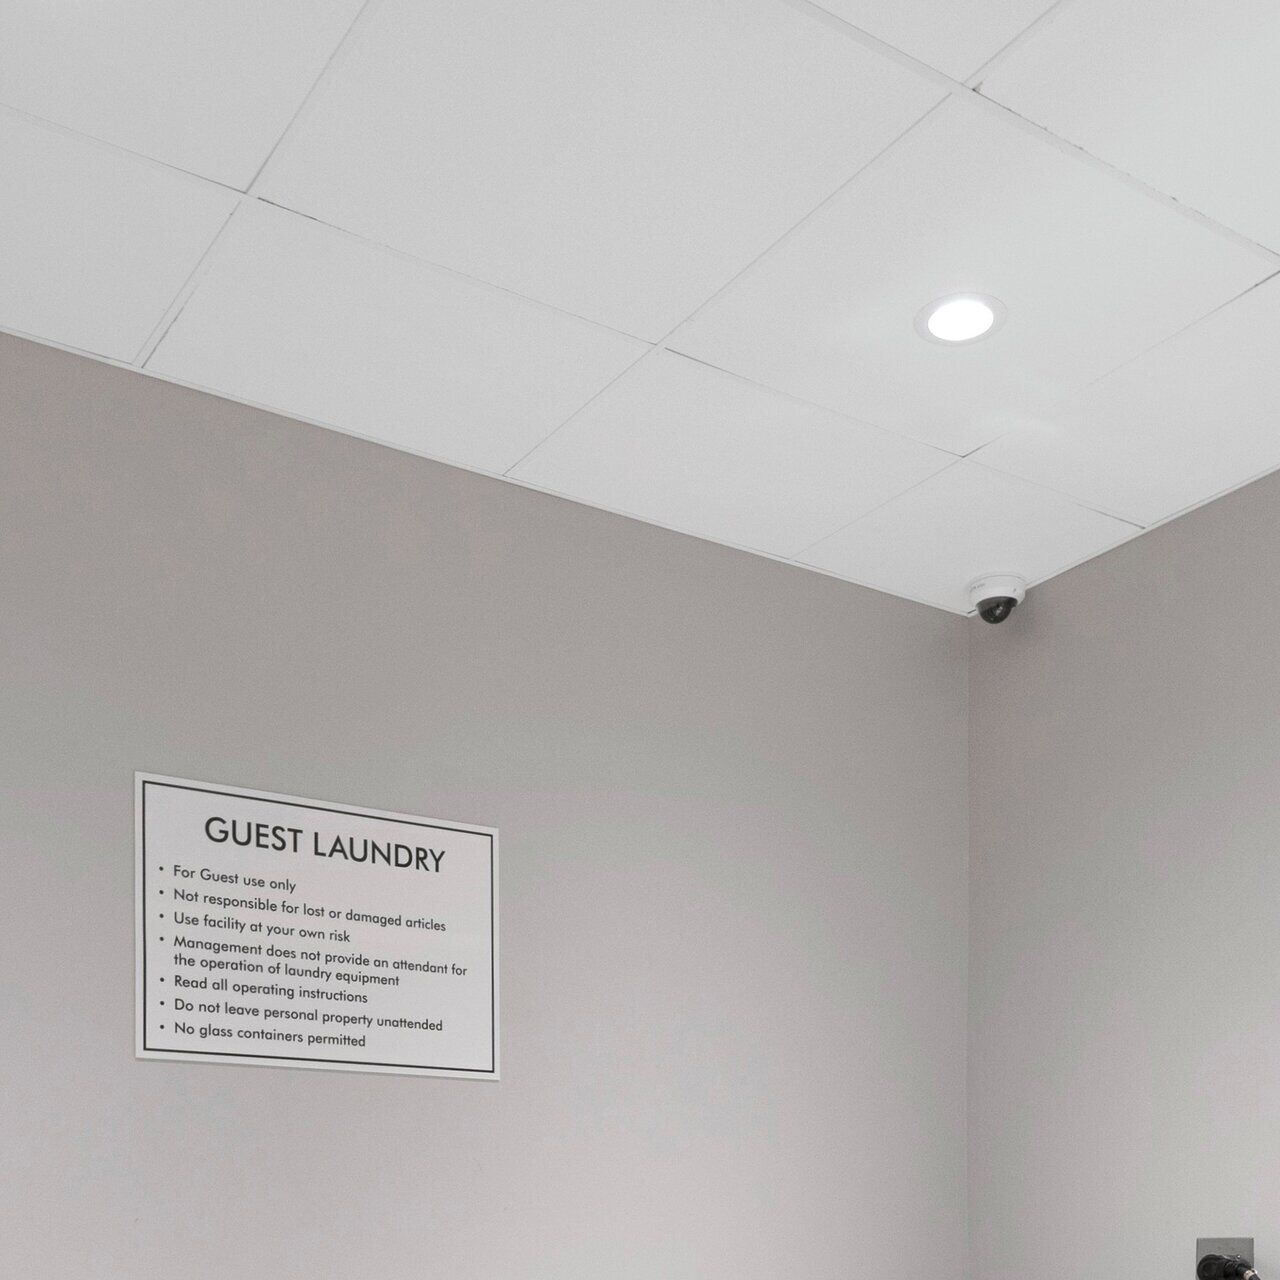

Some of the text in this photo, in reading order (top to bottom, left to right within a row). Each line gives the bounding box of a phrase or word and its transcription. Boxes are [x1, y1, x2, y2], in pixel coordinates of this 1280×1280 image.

[204, 816, 446, 873] GUEST LAUNDRY
[173, 864, 297, 895] For Guest use only
[173, 888, 446, 932] Not responsible for lost or damaged articles
[174, 911, 351, 943] Use facility at your own risk
[173, 935, 468, 976] Management does not provide an attendant for
[173, 952, 400, 986] the operation of laundry equipment
[174, 974, 368, 1004] Read all operating instructions
[174, 997, 443, 1032] Do not leave personal property unattended
[174, 1022, 366, 1047] No glass containers permitted
